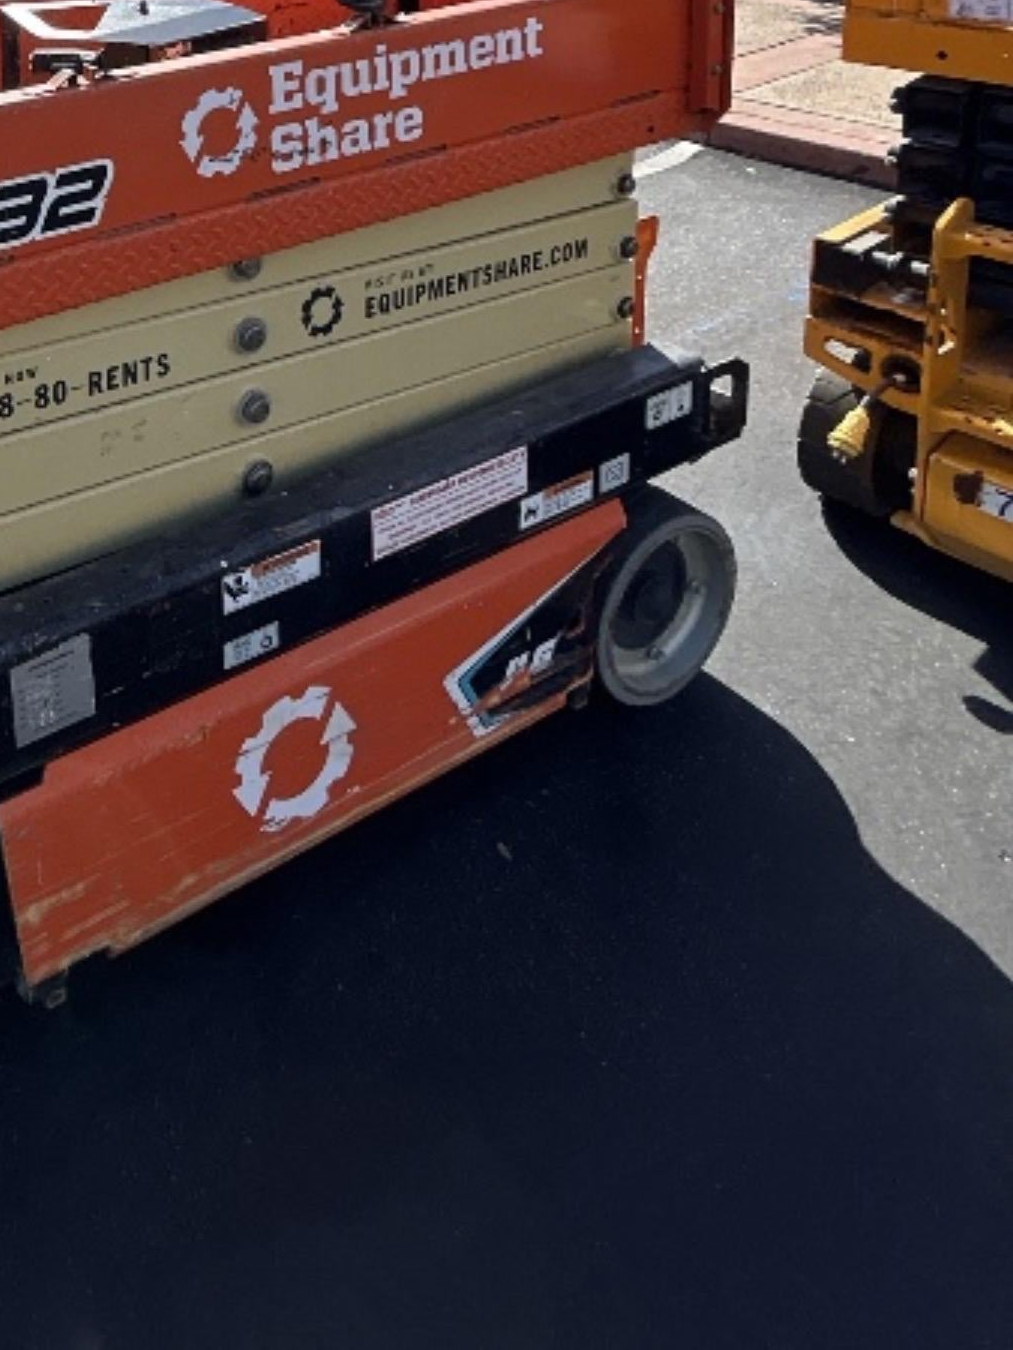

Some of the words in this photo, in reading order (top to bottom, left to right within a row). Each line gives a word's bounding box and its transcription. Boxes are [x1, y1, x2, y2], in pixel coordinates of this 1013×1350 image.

[268, 17, 544, 114] Equipment
[270, 105, 424, 174] Share
[364, 238, 589, 319] EQUIPMENTSHARE.COM
